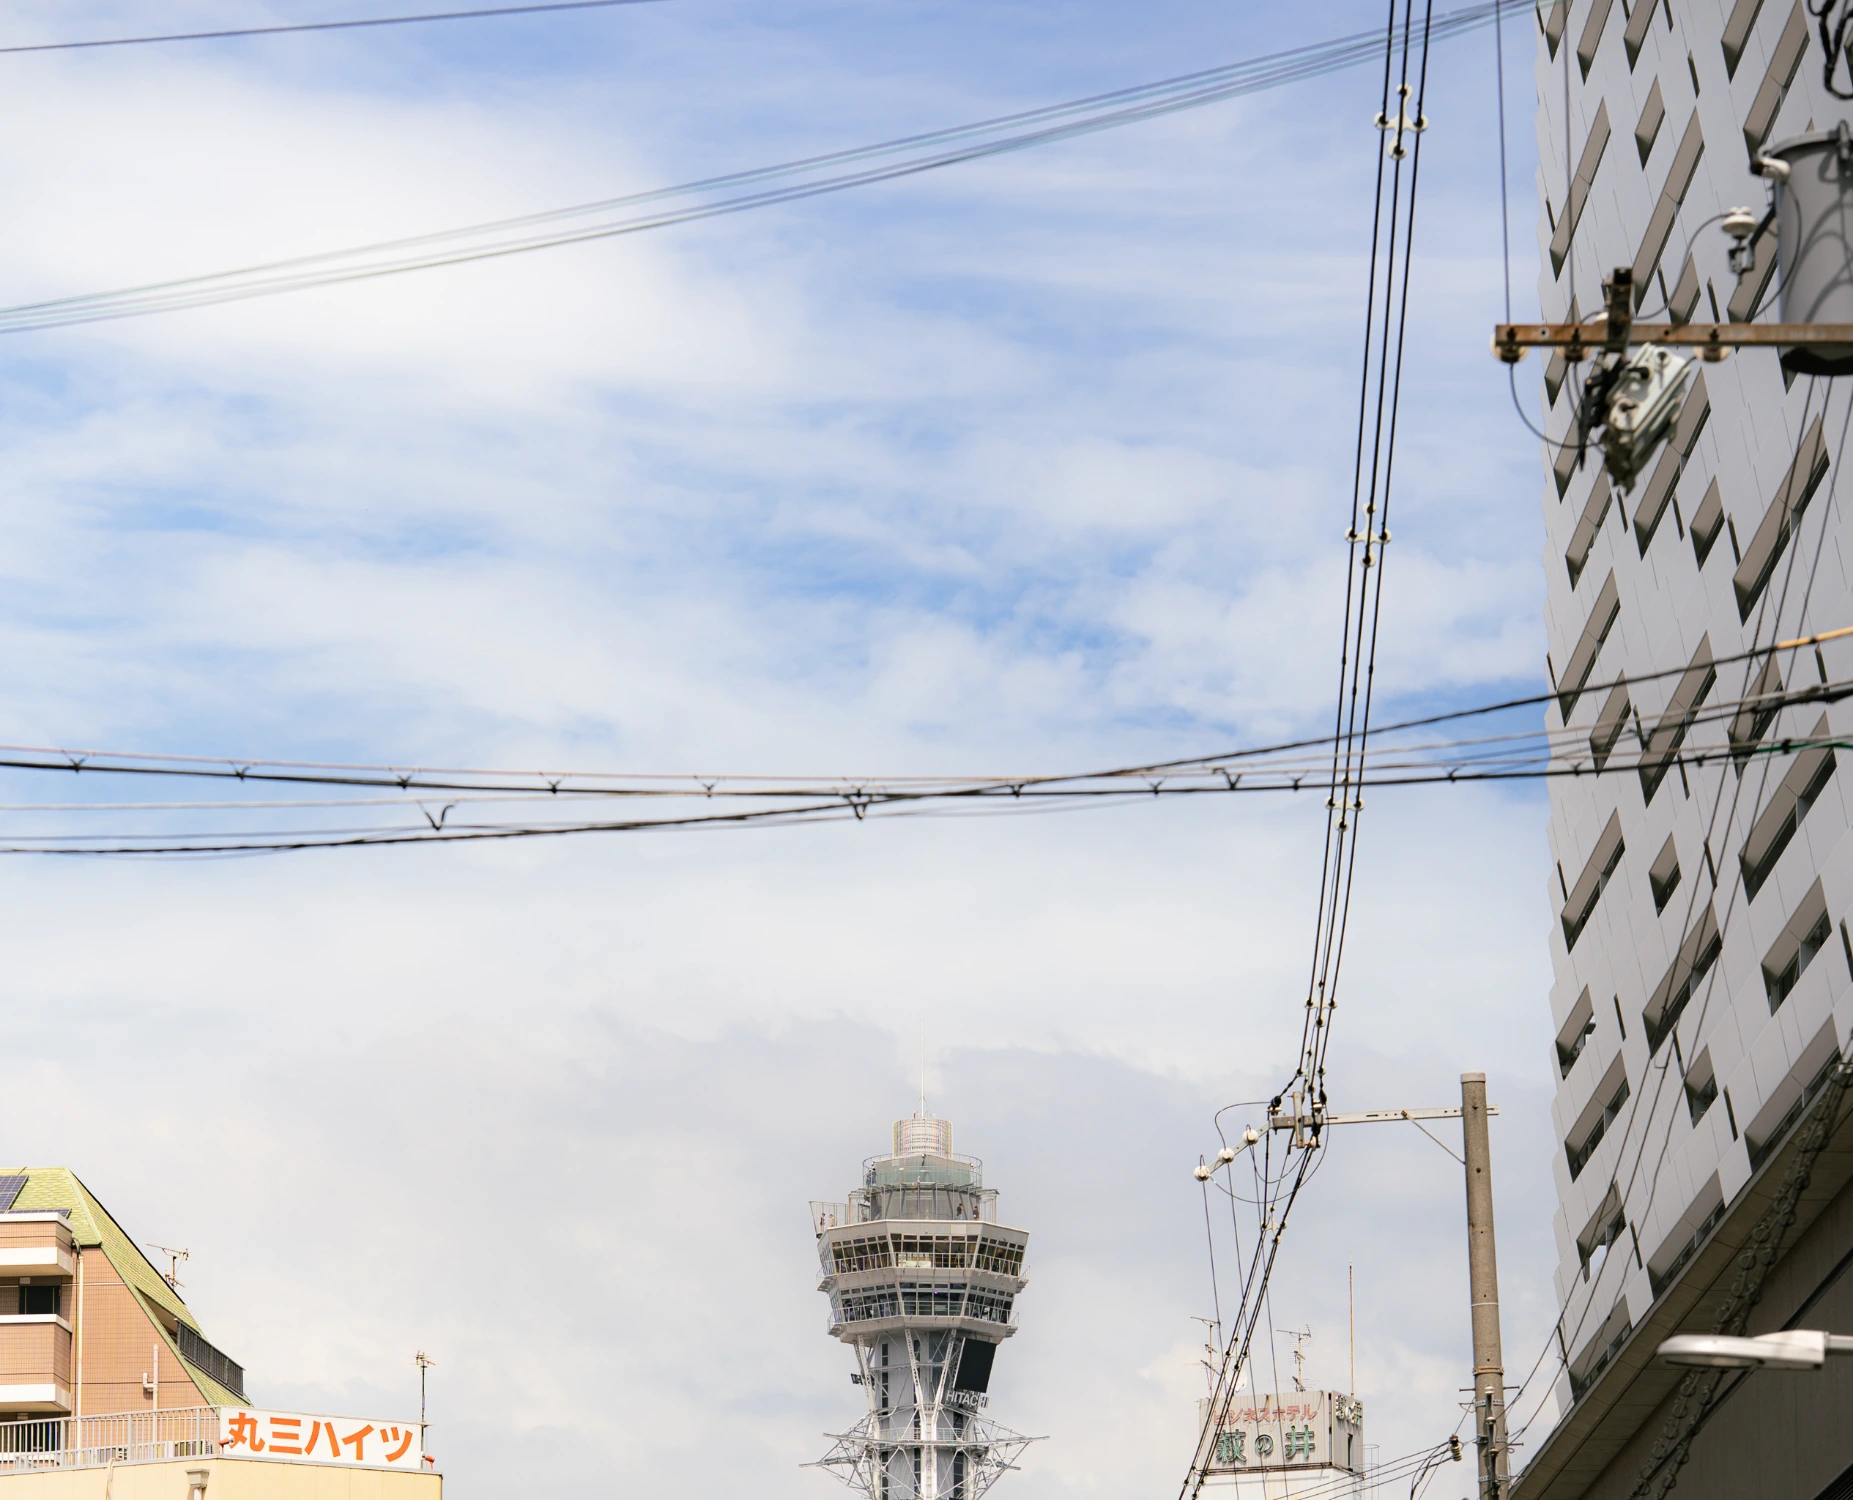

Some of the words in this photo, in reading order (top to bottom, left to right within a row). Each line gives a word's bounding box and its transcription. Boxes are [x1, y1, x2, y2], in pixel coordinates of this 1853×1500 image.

[945, 1390, 990, 1408] HITACHI
[228, 1412, 414, 1463] 丸三ハイツ
